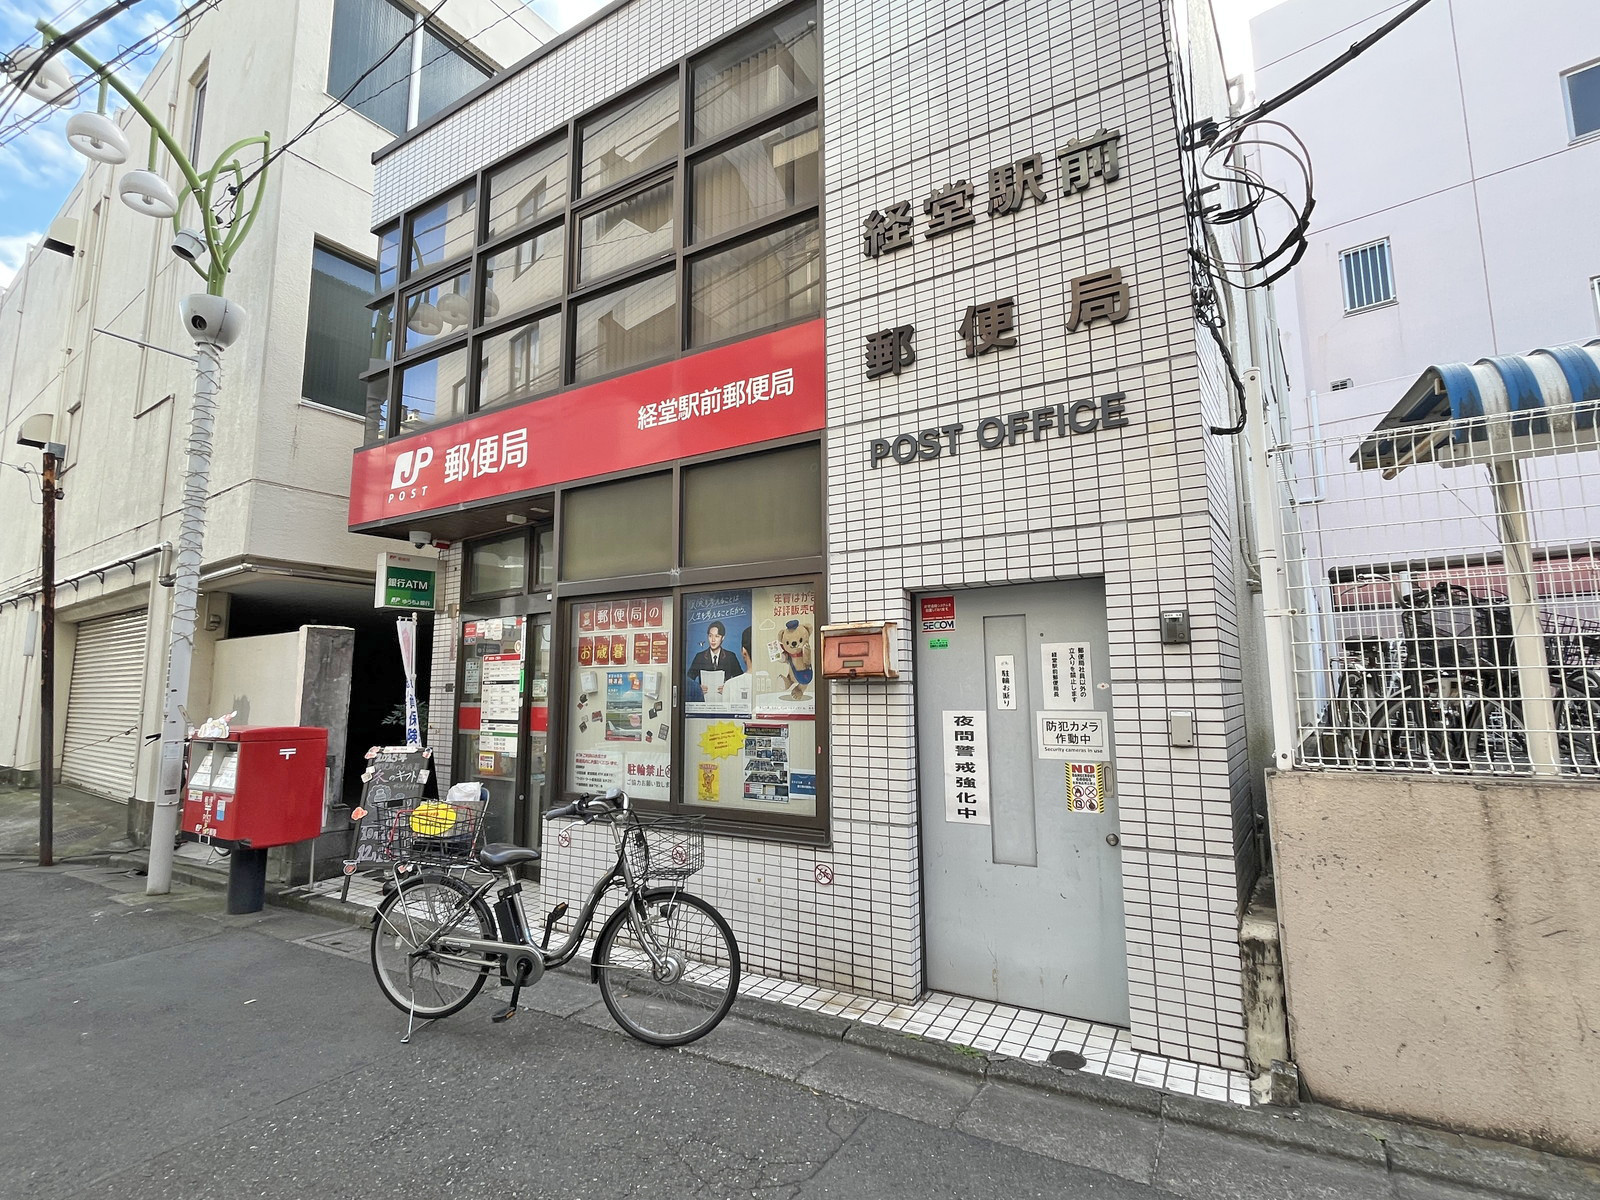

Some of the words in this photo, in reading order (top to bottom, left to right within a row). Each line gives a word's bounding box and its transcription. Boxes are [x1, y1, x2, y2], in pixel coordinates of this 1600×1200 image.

[862, 127, 1121, 258] 経堂駅前
[865, 266, 1131, 378] 郵便局
[637, 367, 794, 430] 経堂駅前郵便局
[870, 422, 963, 469] POST
[977, 391, 1129, 449] OFFICE
[444, 427, 528, 484] 郵便局
[387, 485, 428, 504] POST
[387, 577, 428, 590] 銀行ATM
[597, 606, 659, 624] 郵便局の
[923, 620, 954, 630] SECOM
[580, 643, 625, 660] お歳暮
[1045, 720, 1099, 733] 防犯カメラ
[1055, 733, 1091, 745] 作動中
[627, 763, 665, 778] 駐輪禁止
[953, 715, 977, 819] 夜間警戒強化中
[1071, 764, 1095, 774] NO
[370, 769, 417, 784] 冬のギフト
